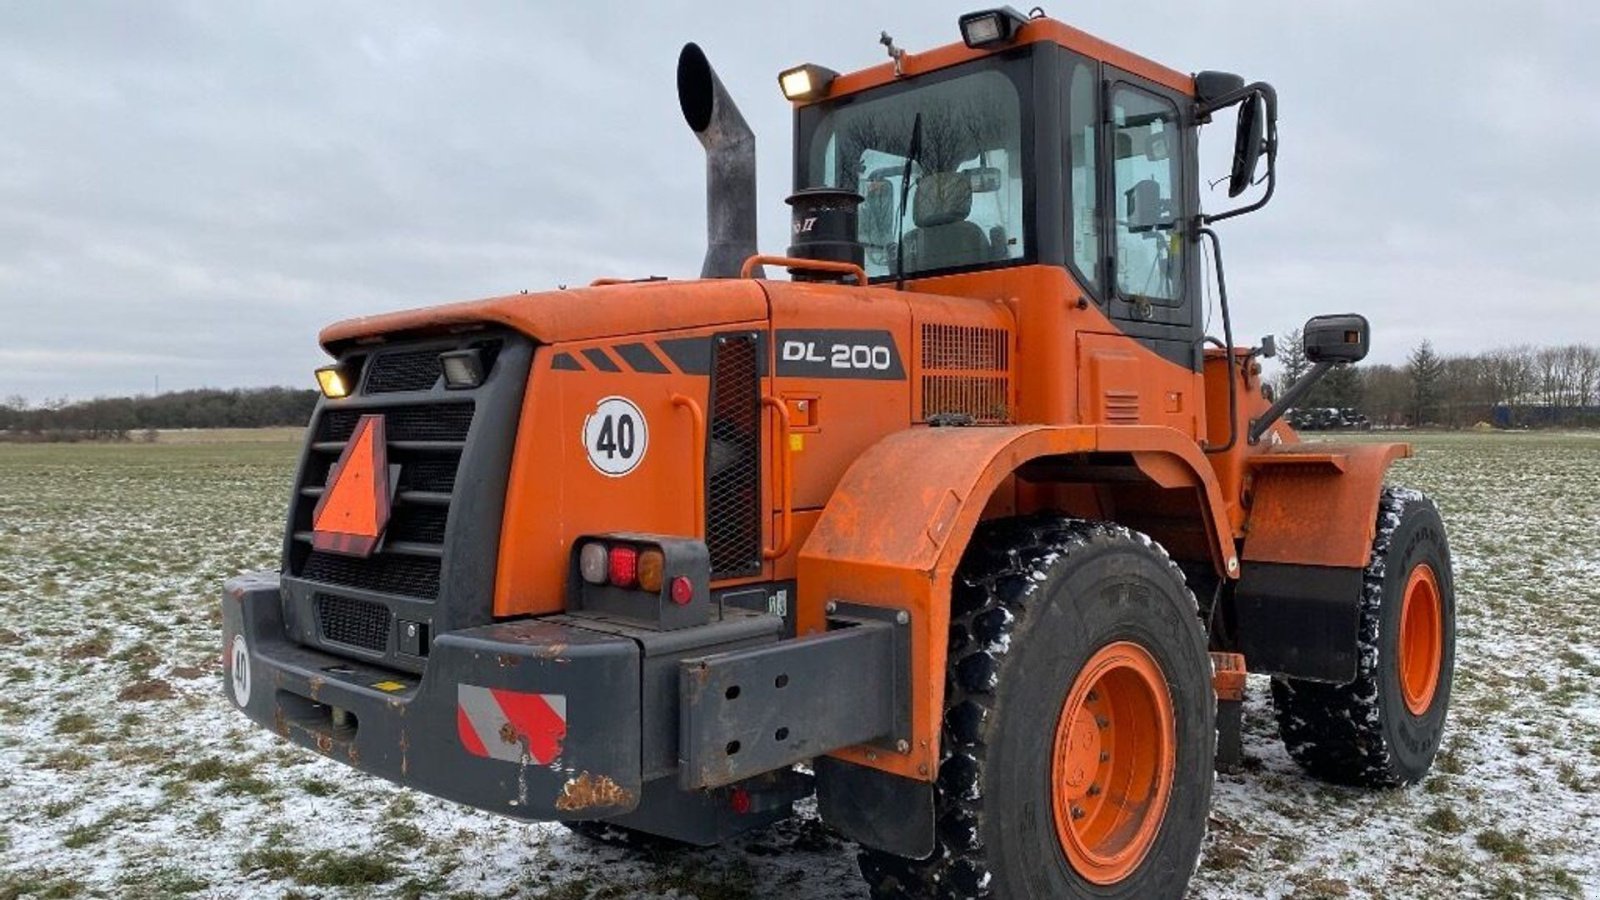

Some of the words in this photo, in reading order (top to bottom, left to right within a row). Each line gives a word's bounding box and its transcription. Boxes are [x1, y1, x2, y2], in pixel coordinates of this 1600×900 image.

[783, 341, 826, 361] DL
[831, 344, 890, 369] 200
[597, 414, 634, 459] 40
[235, 650, 247, 691] 40
